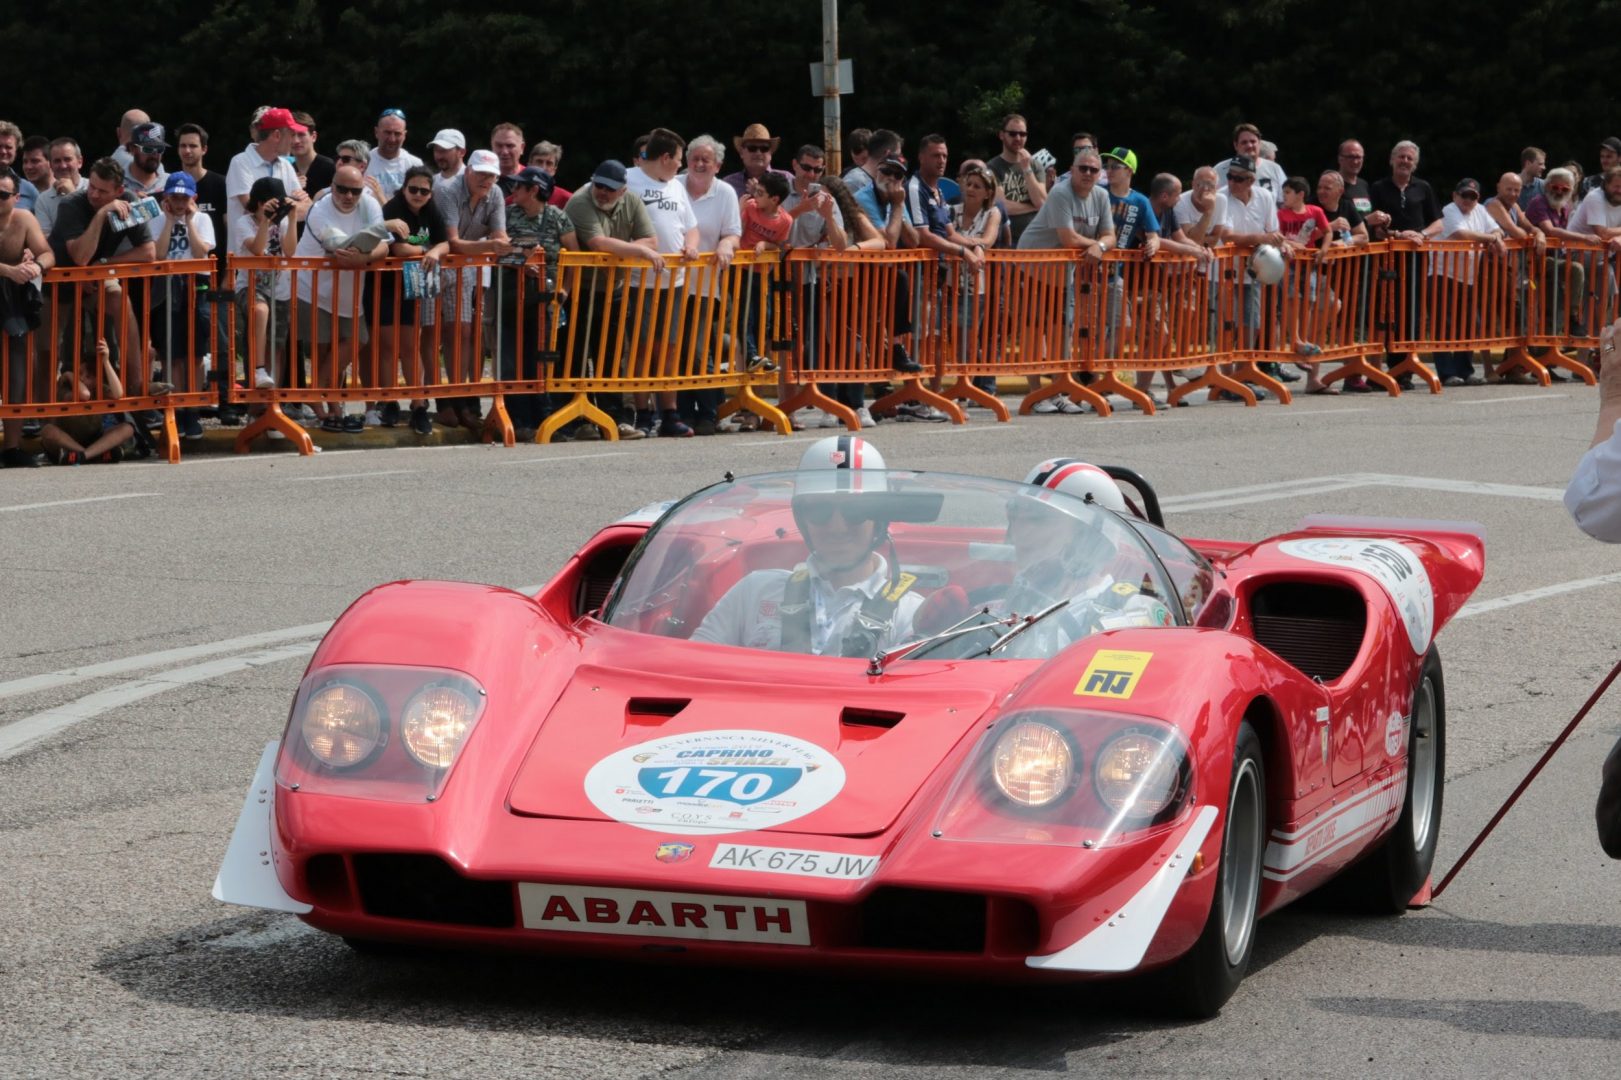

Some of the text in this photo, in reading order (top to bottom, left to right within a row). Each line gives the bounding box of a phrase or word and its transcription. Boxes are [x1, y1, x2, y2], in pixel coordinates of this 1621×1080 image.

[643, 189, 664, 200] JUST
[1126, 205, 1139, 223] GAS
[676, 749, 774, 758] CAPRINO
[657, 767, 773, 801] 170
[825, 857, 874, 876] JW
[541, 895, 793, 934] ABARTH
